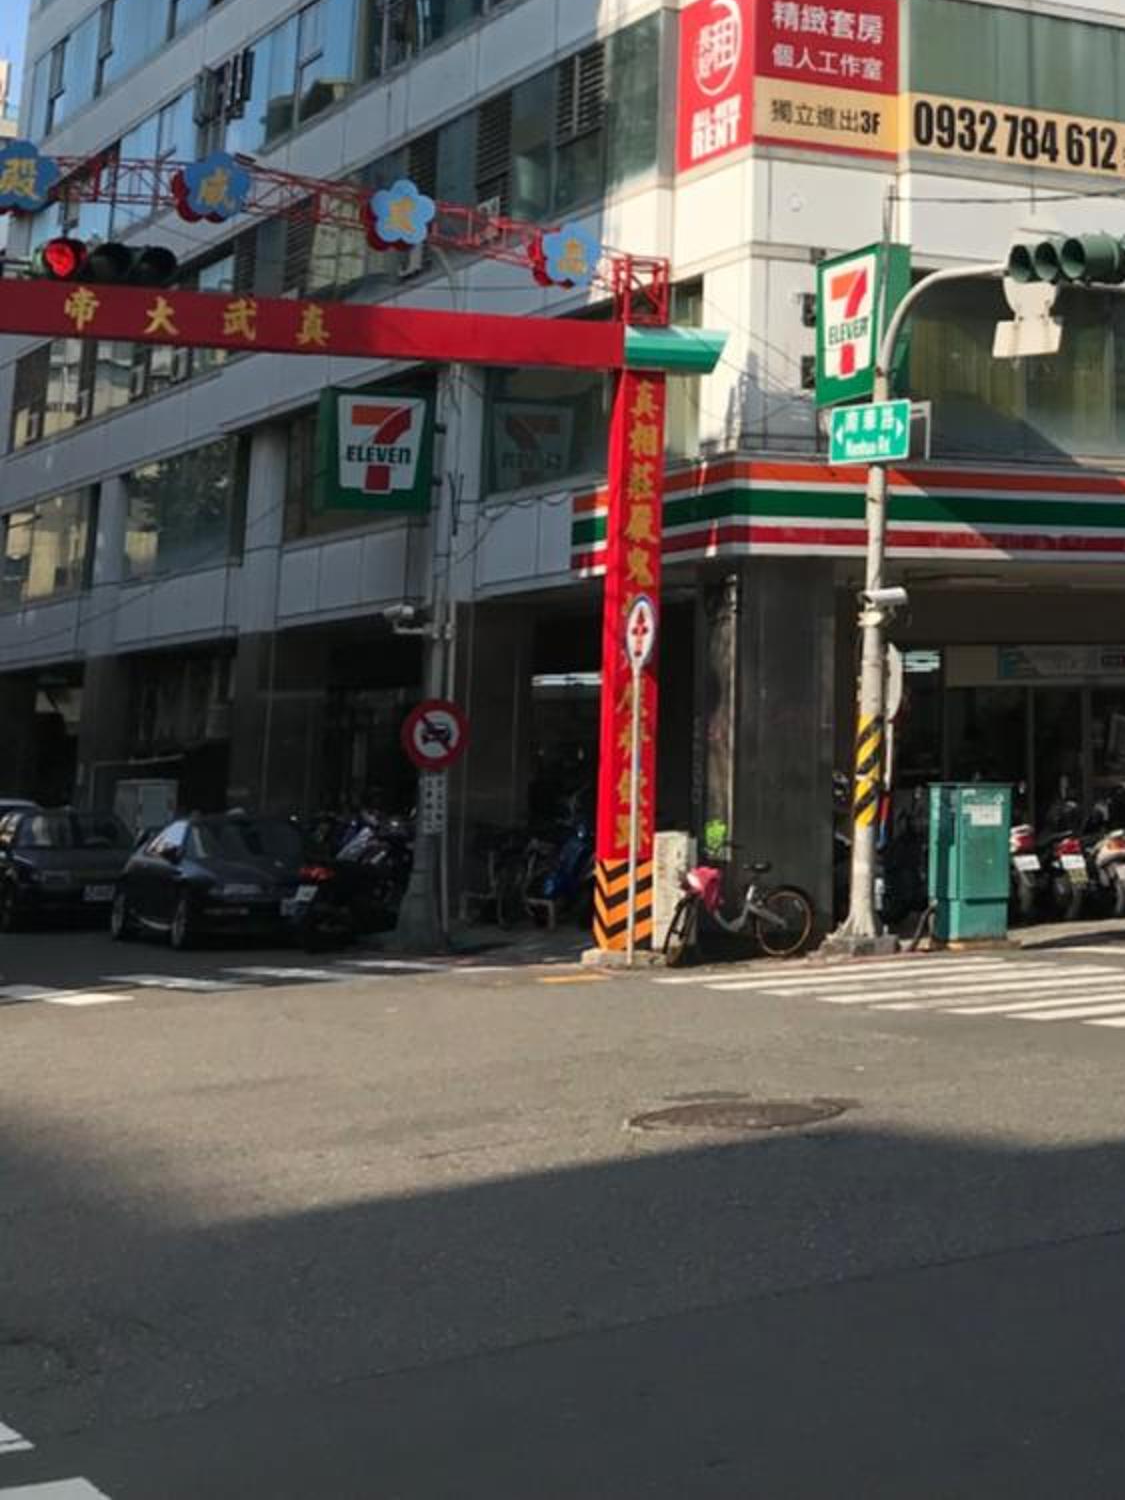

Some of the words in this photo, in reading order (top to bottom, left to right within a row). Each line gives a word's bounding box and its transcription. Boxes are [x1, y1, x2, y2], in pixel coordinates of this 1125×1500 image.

[772, 0, 883, 44] 精緻套房
[772, 43, 883, 81] 個人工作室
